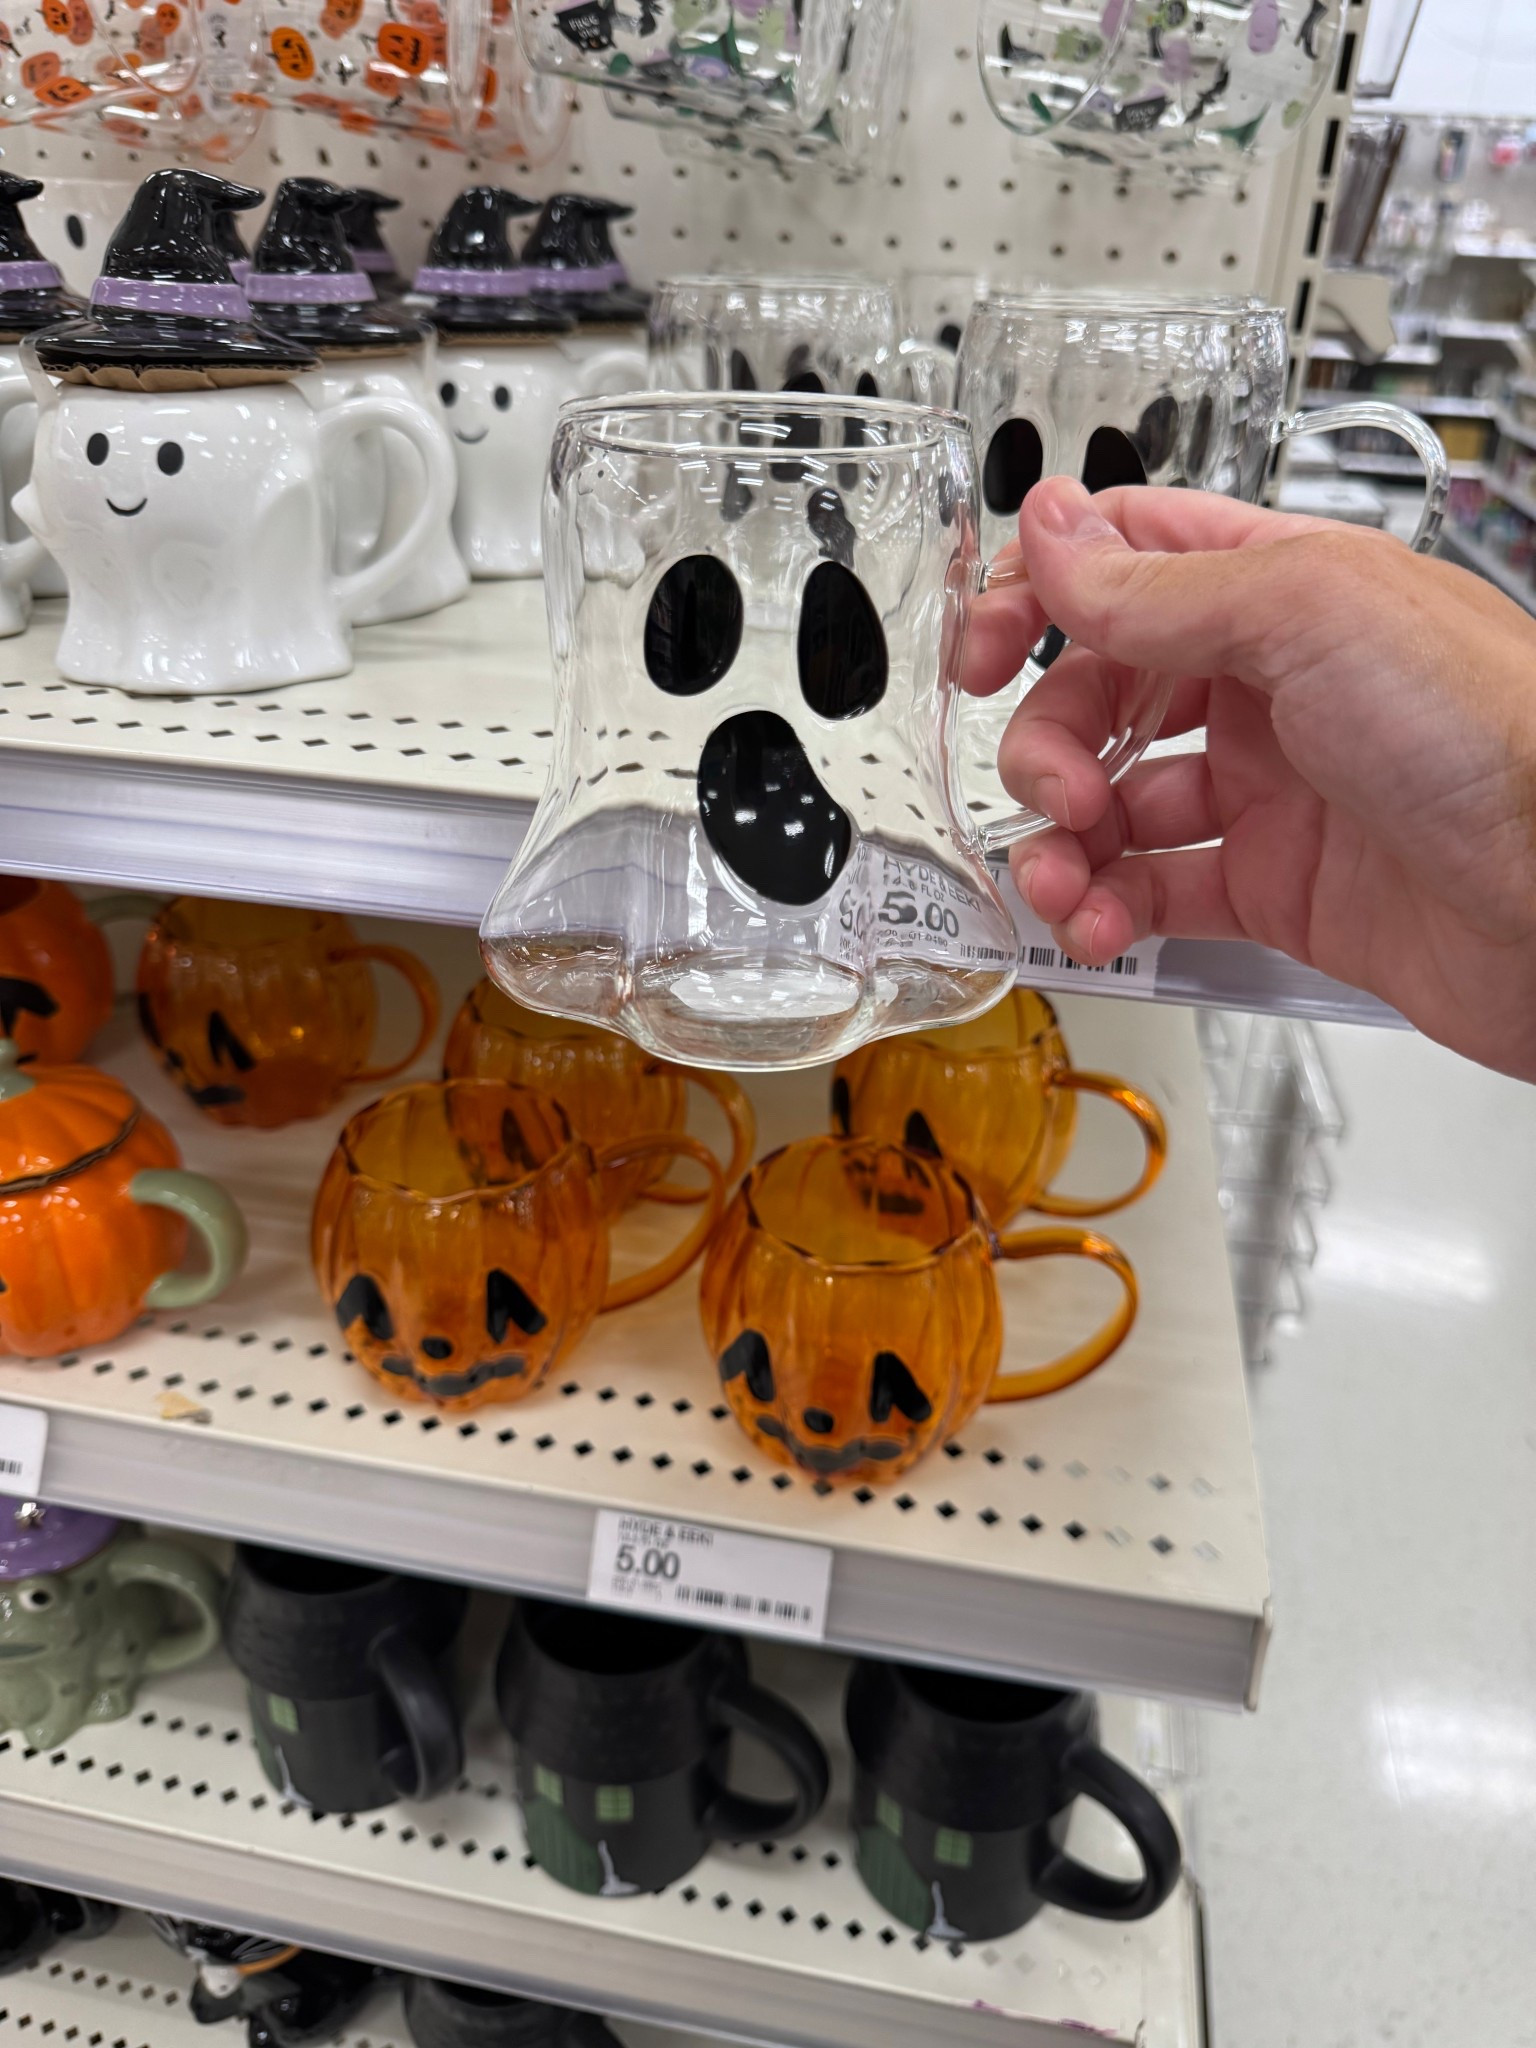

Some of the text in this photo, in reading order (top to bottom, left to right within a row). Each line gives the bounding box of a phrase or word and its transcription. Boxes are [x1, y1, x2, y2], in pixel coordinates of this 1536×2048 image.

[884, 854, 937, 885] HYDE
[921, 883, 932, 898] FL
[878, 891, 959, 937] 5.00
[616, 1544, 681, 1580] 5.00
